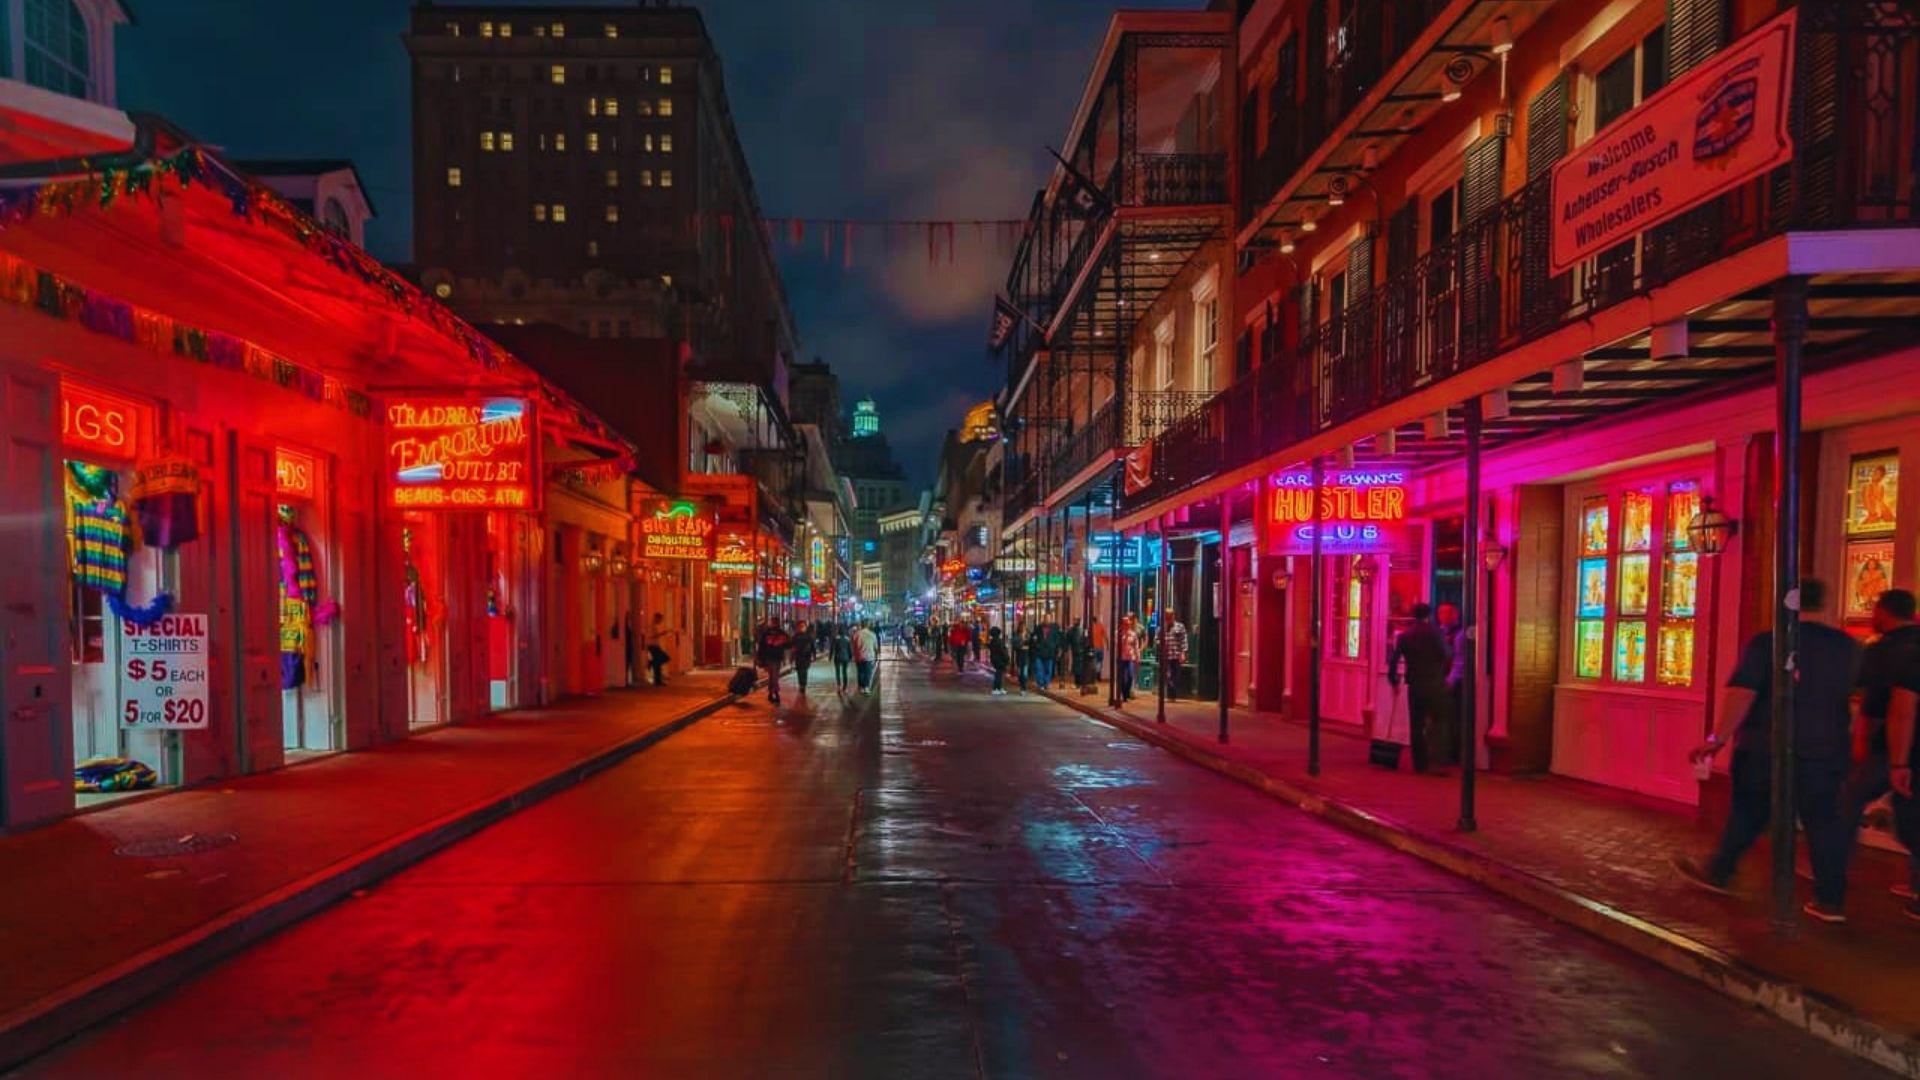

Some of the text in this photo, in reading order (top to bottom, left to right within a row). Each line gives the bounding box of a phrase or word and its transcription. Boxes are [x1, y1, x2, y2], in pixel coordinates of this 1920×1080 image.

[1586, 124, 1656, 178] Welcome
[1563, 140, 1680, 224] Anheuser-Busch
[1575, 186, 1662, 248] Wholesalers
[388, 403, 481, 427] TRADERS
[391, 415, 527, 471] EMPORIUM
[441, 461, 522, 482] OUTLET
[1275, 485, 1405, 522] HUSTLER
[642, 514, 713, 537] BIG EASY
[131, 639, 199, 652] T-SHIRTS
[170, 670, 205, 682] EACH
[155, 686, 173, 697] OR
[125, 698, 204, 723] 5 FOR $20
